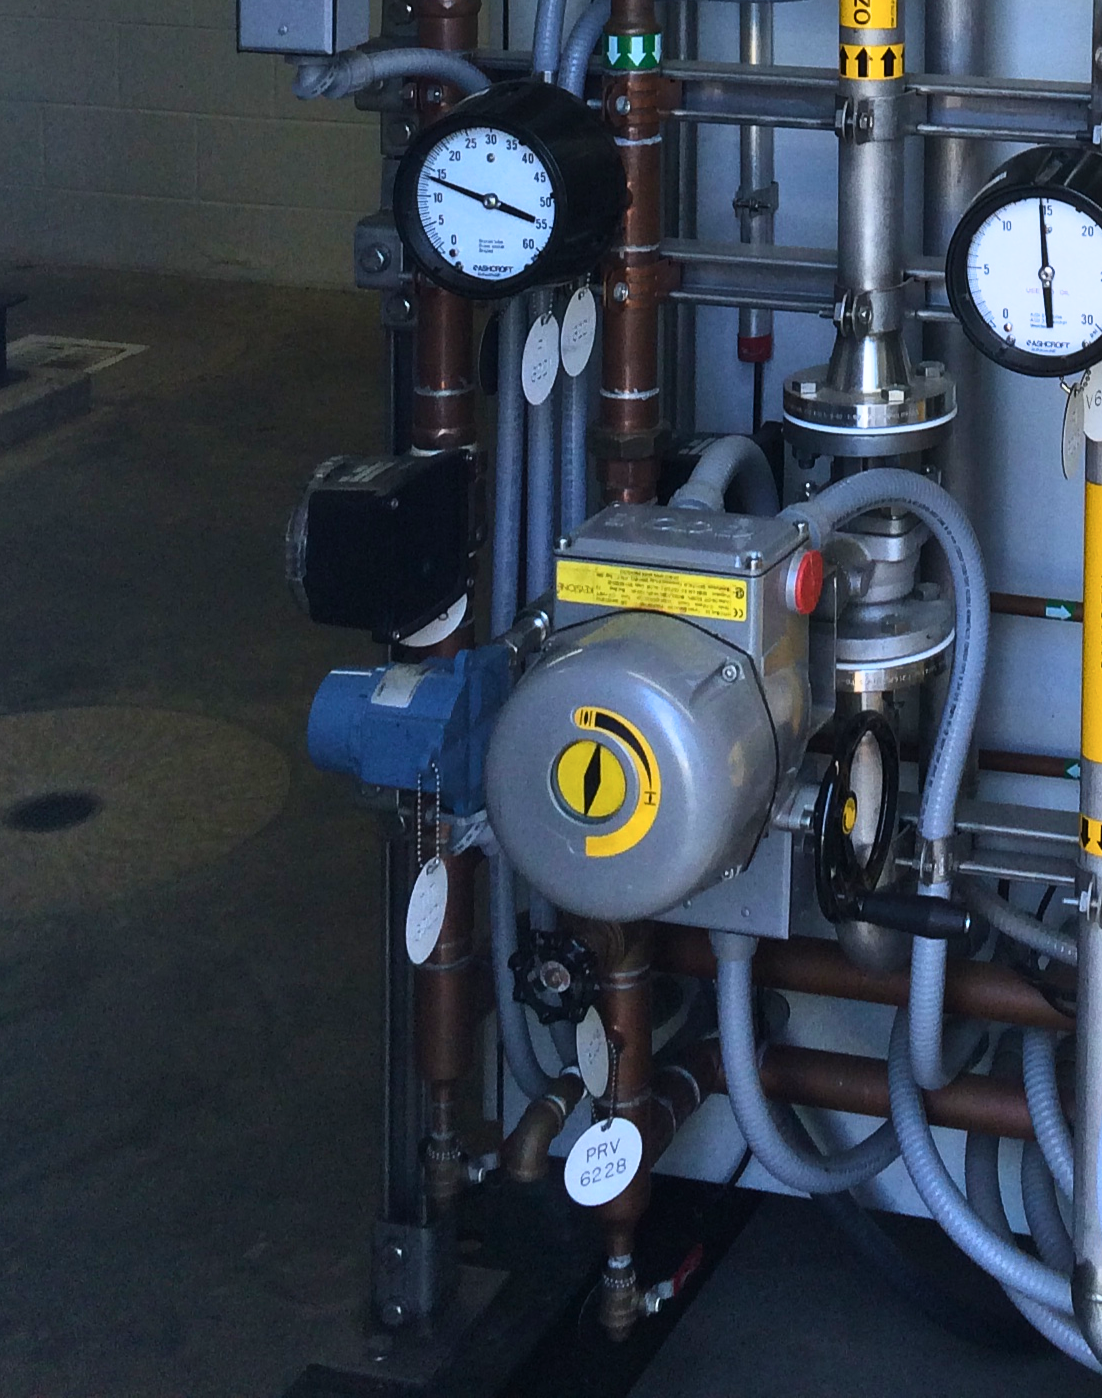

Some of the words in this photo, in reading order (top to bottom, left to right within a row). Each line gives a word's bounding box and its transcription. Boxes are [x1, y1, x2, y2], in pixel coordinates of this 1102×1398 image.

[465, 138, 477, 149] 25
[485, 133, 497, 145] 30
[506, 139, 518, 151] 35
[449, 150, 461, 162] 20
[521, 152, 534, 164] 40
[437, 168, 447, 179] 15
[533, 171, 546, 183] 45
[433, 192, 443, 203] 10
[539, 196, 551, 208] 50
[1043, 205, 1053, 216] 15
[438, 215, 444, 226] 5
[535, 218, 547, 230] 55
[1002, 220, 1012, 231] 10
[1081, 225, 1094, 237] 20
[450, 234, 457, 245] 0
[522, 238, 535, 250] 60
[478, 264, 514, 273] ASHCROFT
[983, 264, 990, 275] 5
[1002, 307, 1009, 319] 0
[1081, 313, 1094, 326] 30
[1031, 339, 1070, 349] ASHCROFT
[586, 1137, 621, 1164] PRV
[580, 1158, 627, 1187] 6228
